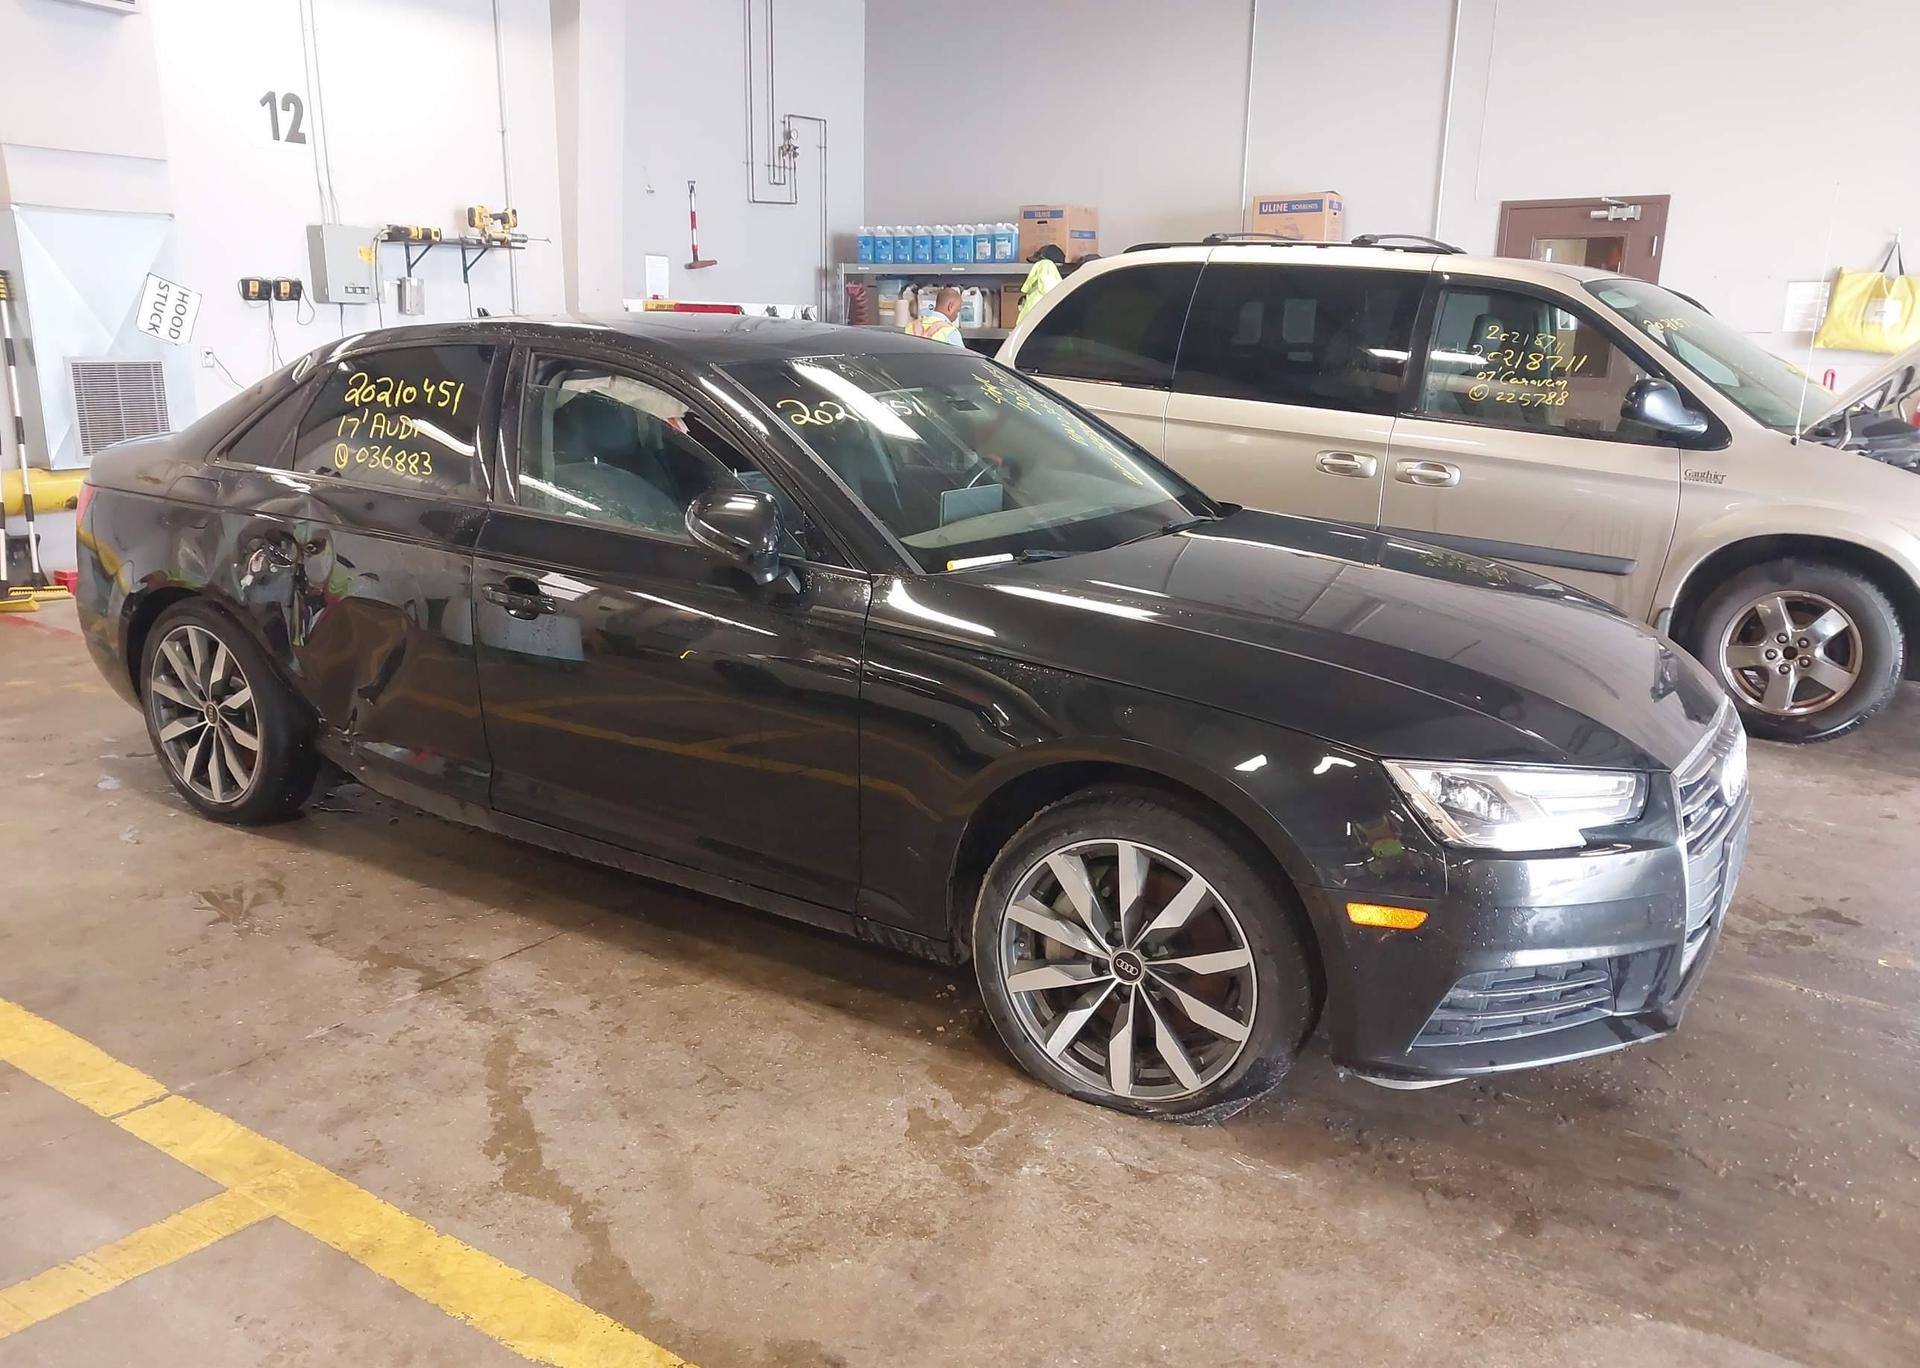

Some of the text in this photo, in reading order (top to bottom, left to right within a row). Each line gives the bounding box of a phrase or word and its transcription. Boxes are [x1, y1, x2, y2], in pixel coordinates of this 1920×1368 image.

[259, 90, 307, 144] 12
[1261, 202, 1289, 213] ULINE
[147, 280, 170, 334] STUCK
[168, 290, 190, 340] HOOD
[344, 372, 465, 416] 20210451
[1495, 390, 1569, 408] 225788
[355, 445, 433, 475] 036883
[1684, 468, 1727, 481] Gauthier
